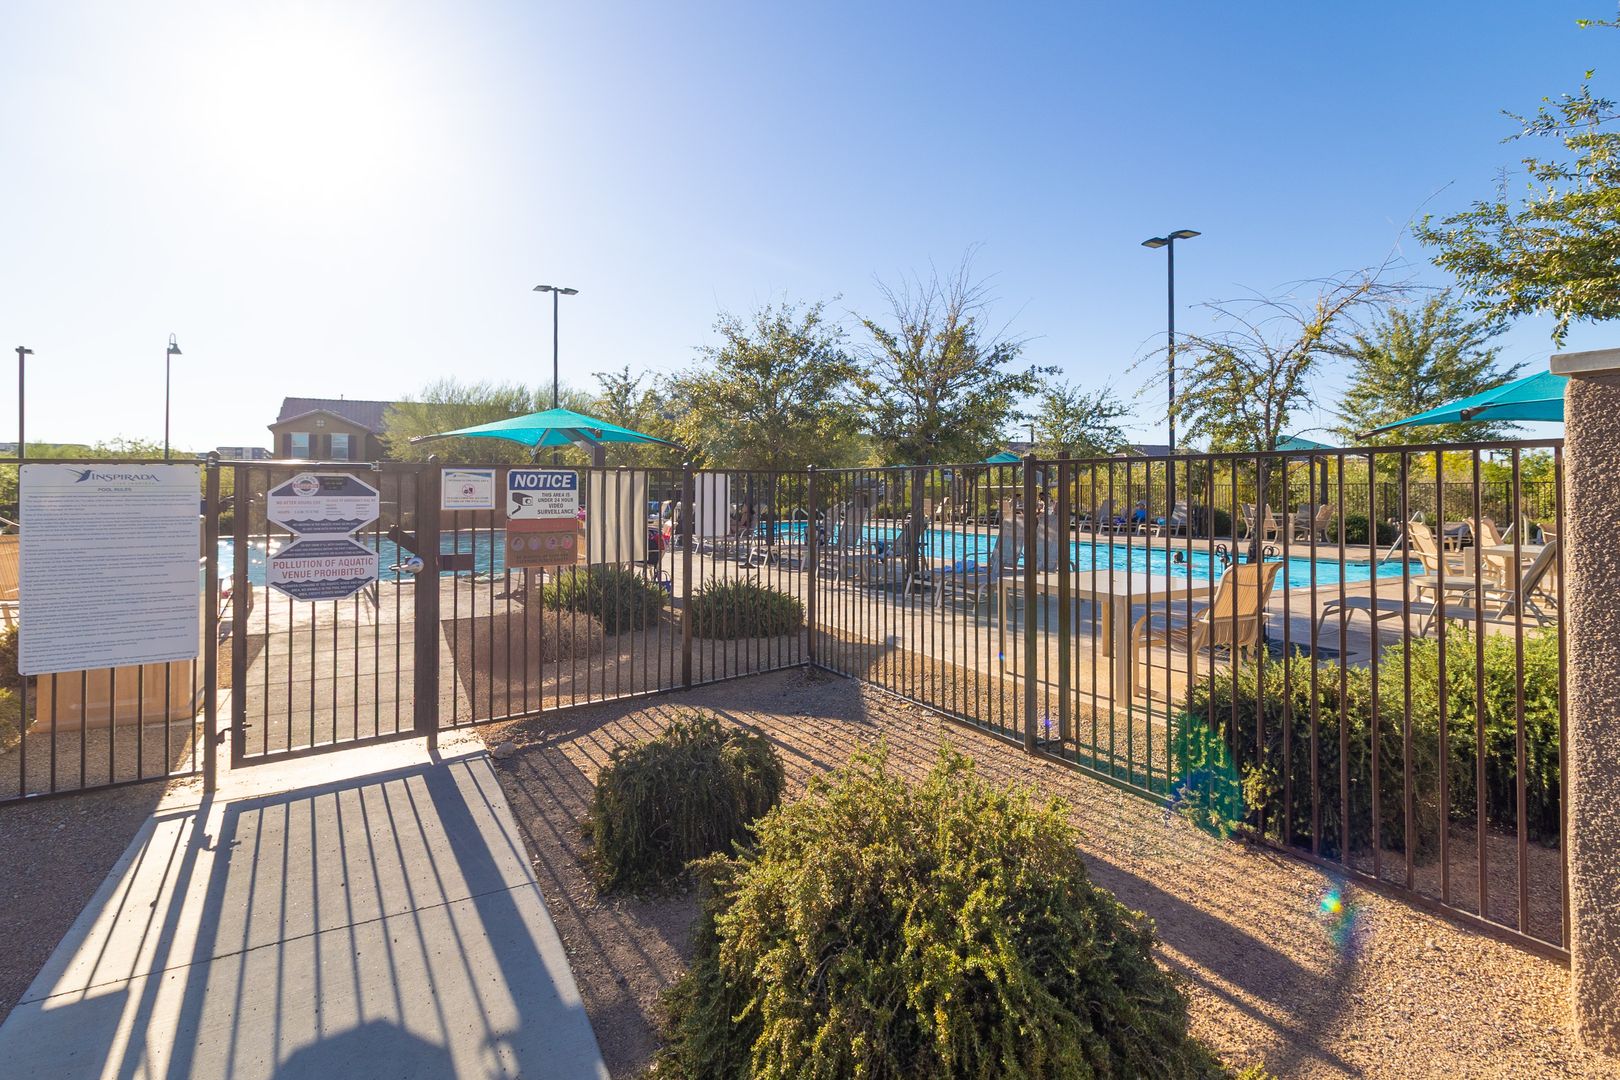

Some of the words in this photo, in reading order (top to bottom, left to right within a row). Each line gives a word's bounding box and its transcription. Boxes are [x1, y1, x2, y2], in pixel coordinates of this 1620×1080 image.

[91, 473, 160, 482] INSPIRADA
[514, 474, 572, 488] NOTICE
[272, 560, 323, 570] POLLUTION
[324, 559, 336, 568] OF
[338, 557, 374, 567] AQUATIC
[281, 570, 312, 579] VENUE
[313, 567, 365, 577] PROHIBITED
